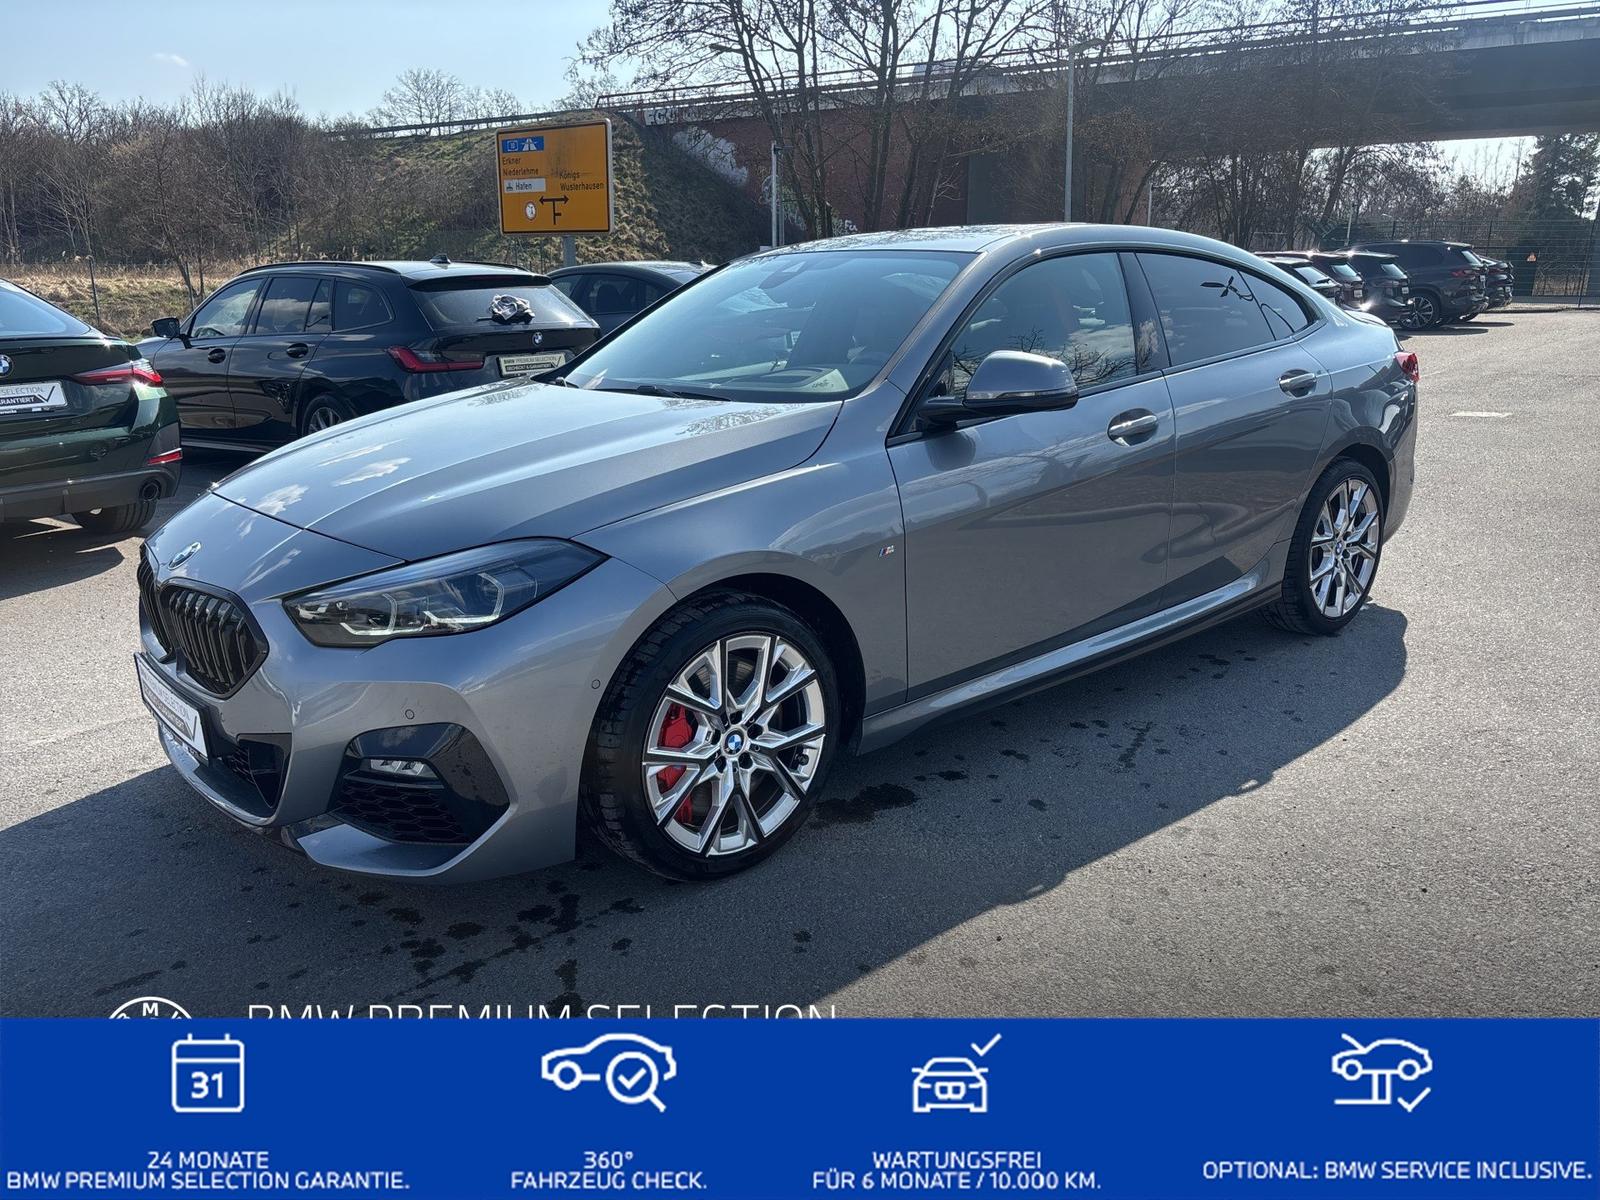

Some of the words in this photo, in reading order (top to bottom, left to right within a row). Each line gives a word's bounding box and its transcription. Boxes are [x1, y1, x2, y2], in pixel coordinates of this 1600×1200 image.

[502, 156, 521, 165] Erkner
[503, 168, 539, 176] Niederlehme
[560, 169, 580, 180] Königs
[515, 181, 533, 190] Hafen
[560, 182, 604, 191] Wusterhausen
[2, 386, 43, 395] SELECTION
